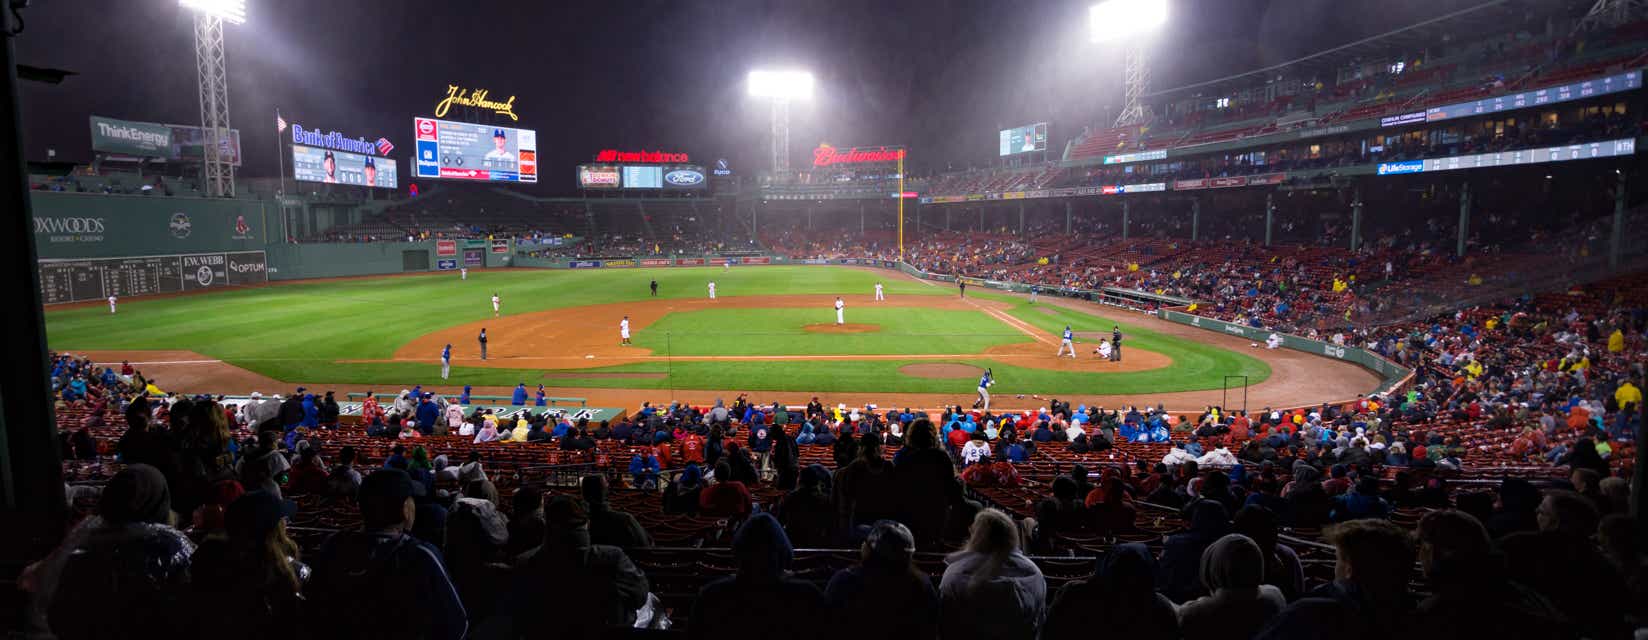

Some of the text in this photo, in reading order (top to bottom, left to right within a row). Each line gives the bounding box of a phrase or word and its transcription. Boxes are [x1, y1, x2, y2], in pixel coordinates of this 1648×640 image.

[435, 84, 518, 121] John Hancock
[97, 122, 168, 147] ThinkEnergy
[292, 123, 376, 155] Bank of America
[672, 173, 696, 184] Ford
[33, 216, 105, 233] OXWOODS
[199, 255, 224, 266] WEBB
[238, 263, 265, 273] OPTUM
